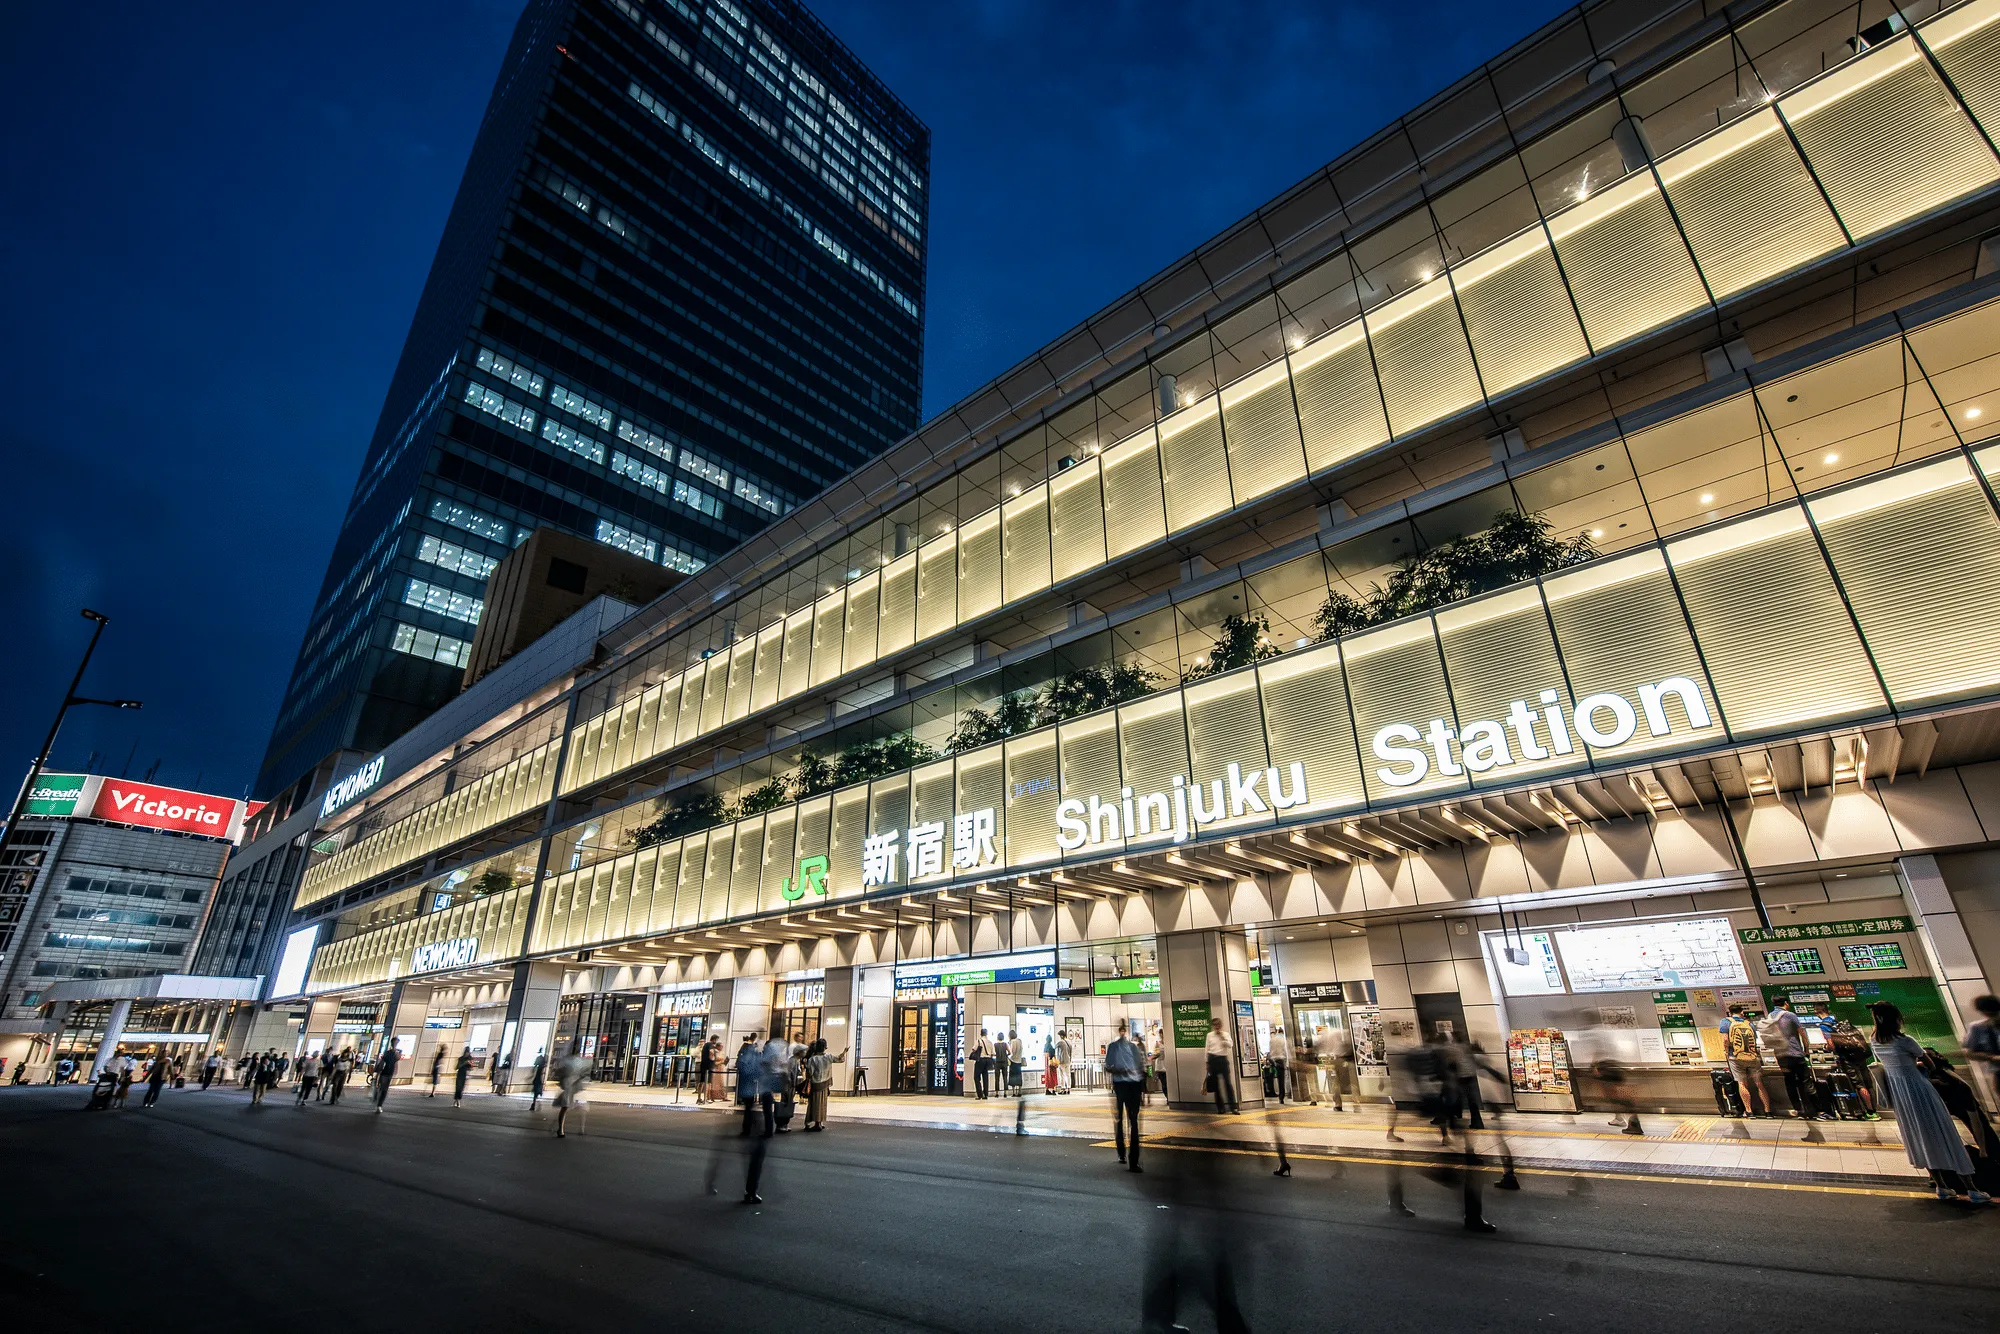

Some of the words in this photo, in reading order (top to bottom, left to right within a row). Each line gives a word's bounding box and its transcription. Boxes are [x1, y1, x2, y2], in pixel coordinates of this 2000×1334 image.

[29, 788, 81, 798] L-Breath
[112, 789, 222, 825] Victoria
[782, 854, 829, 901] JR
[862, 807, 997, 886] 新宿駅
[1055, 761, 1308, 849] Shinjuku
[1372, 676, 1711, 787] Station
[957, 1003, 965, 1058] PIZZA
